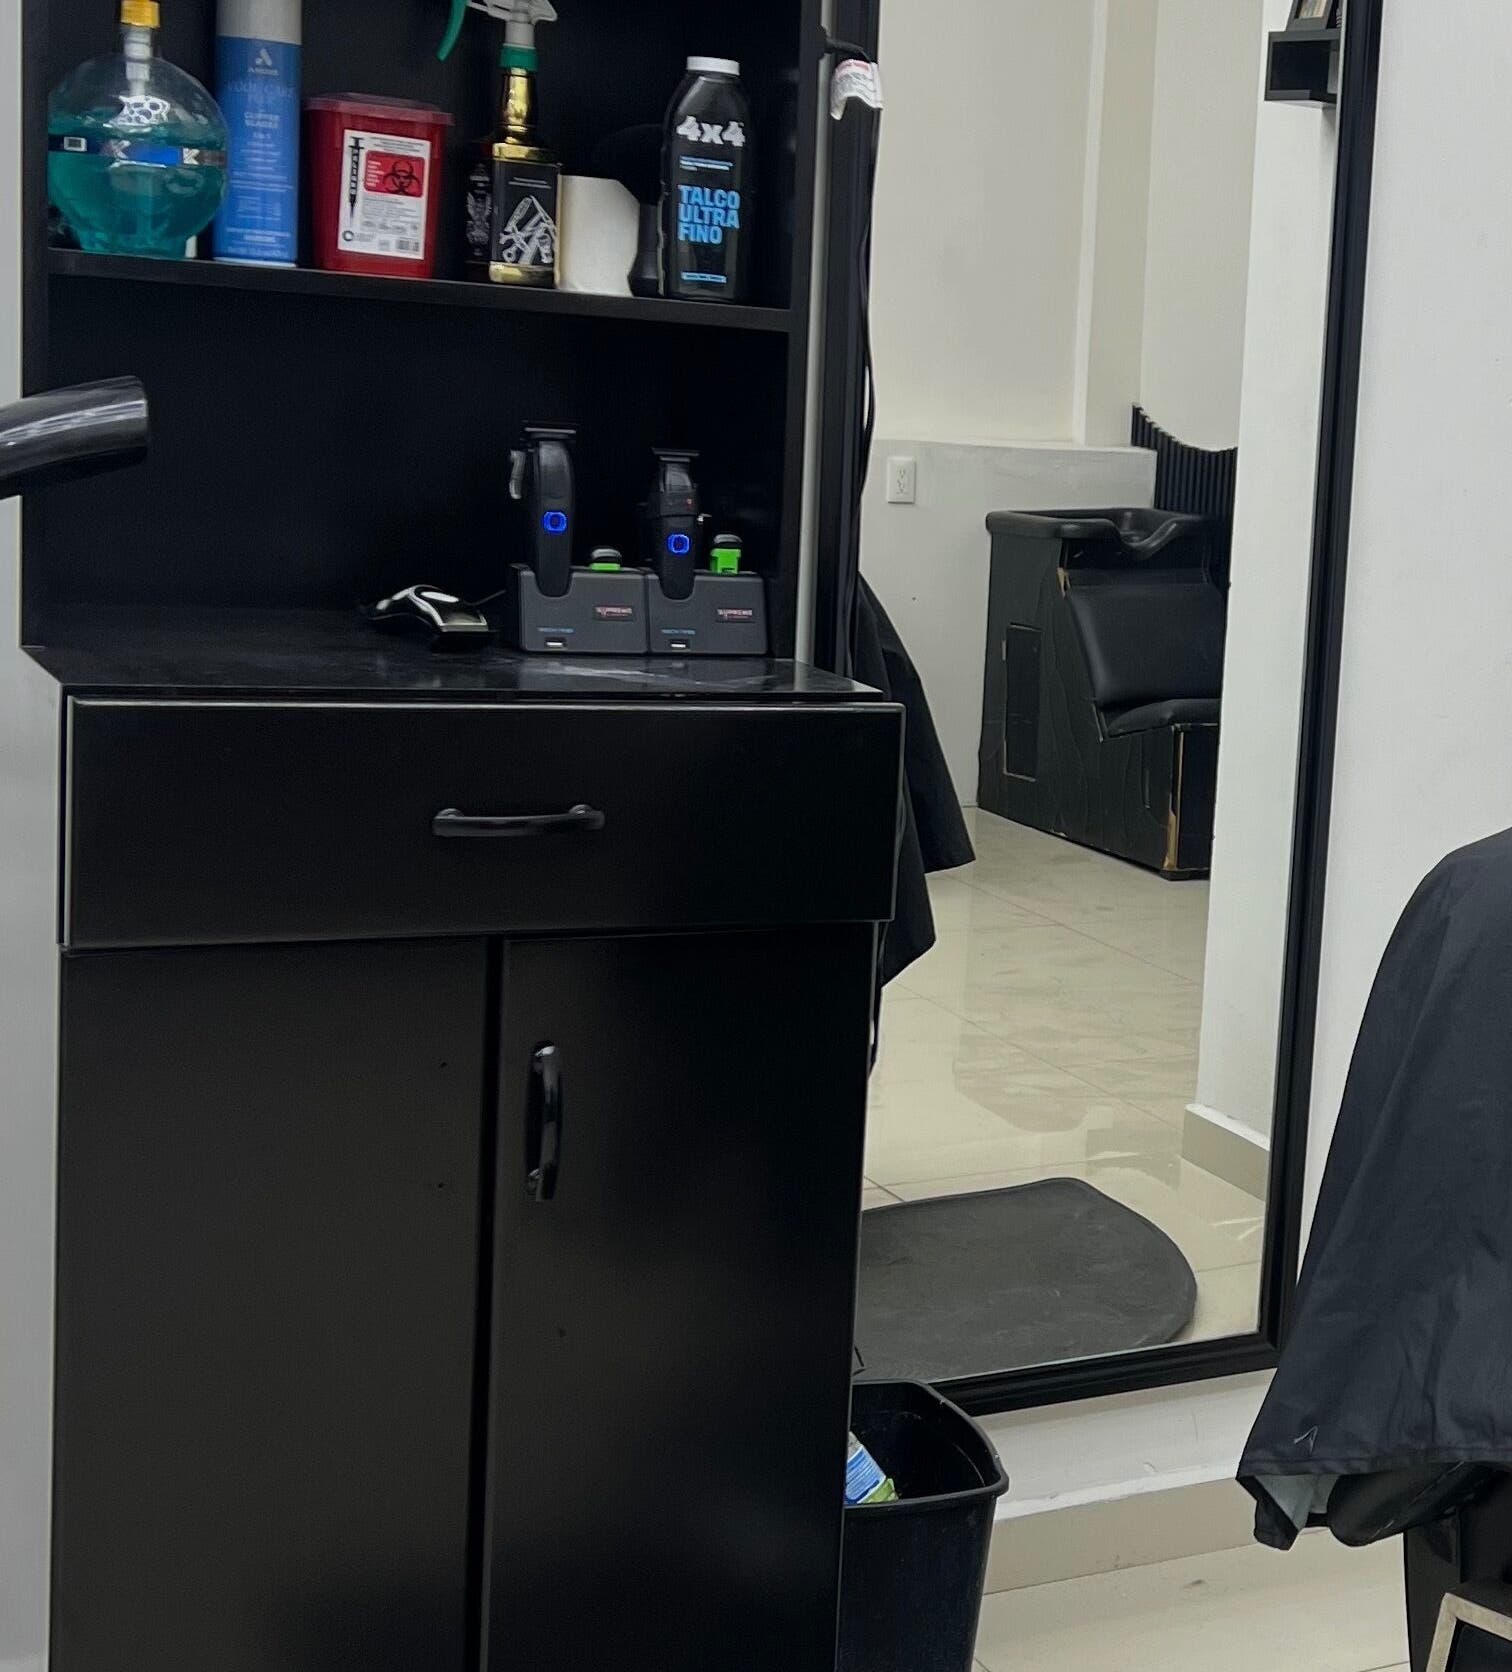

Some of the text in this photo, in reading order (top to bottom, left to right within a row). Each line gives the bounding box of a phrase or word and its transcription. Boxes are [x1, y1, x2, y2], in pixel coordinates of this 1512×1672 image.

[676, 115, 746, 147] 4x4
[678, 185, 741, 210] TALCO
[678, 203, 741, 229] ULTRA
[678, 222, 723, 244] FINO
